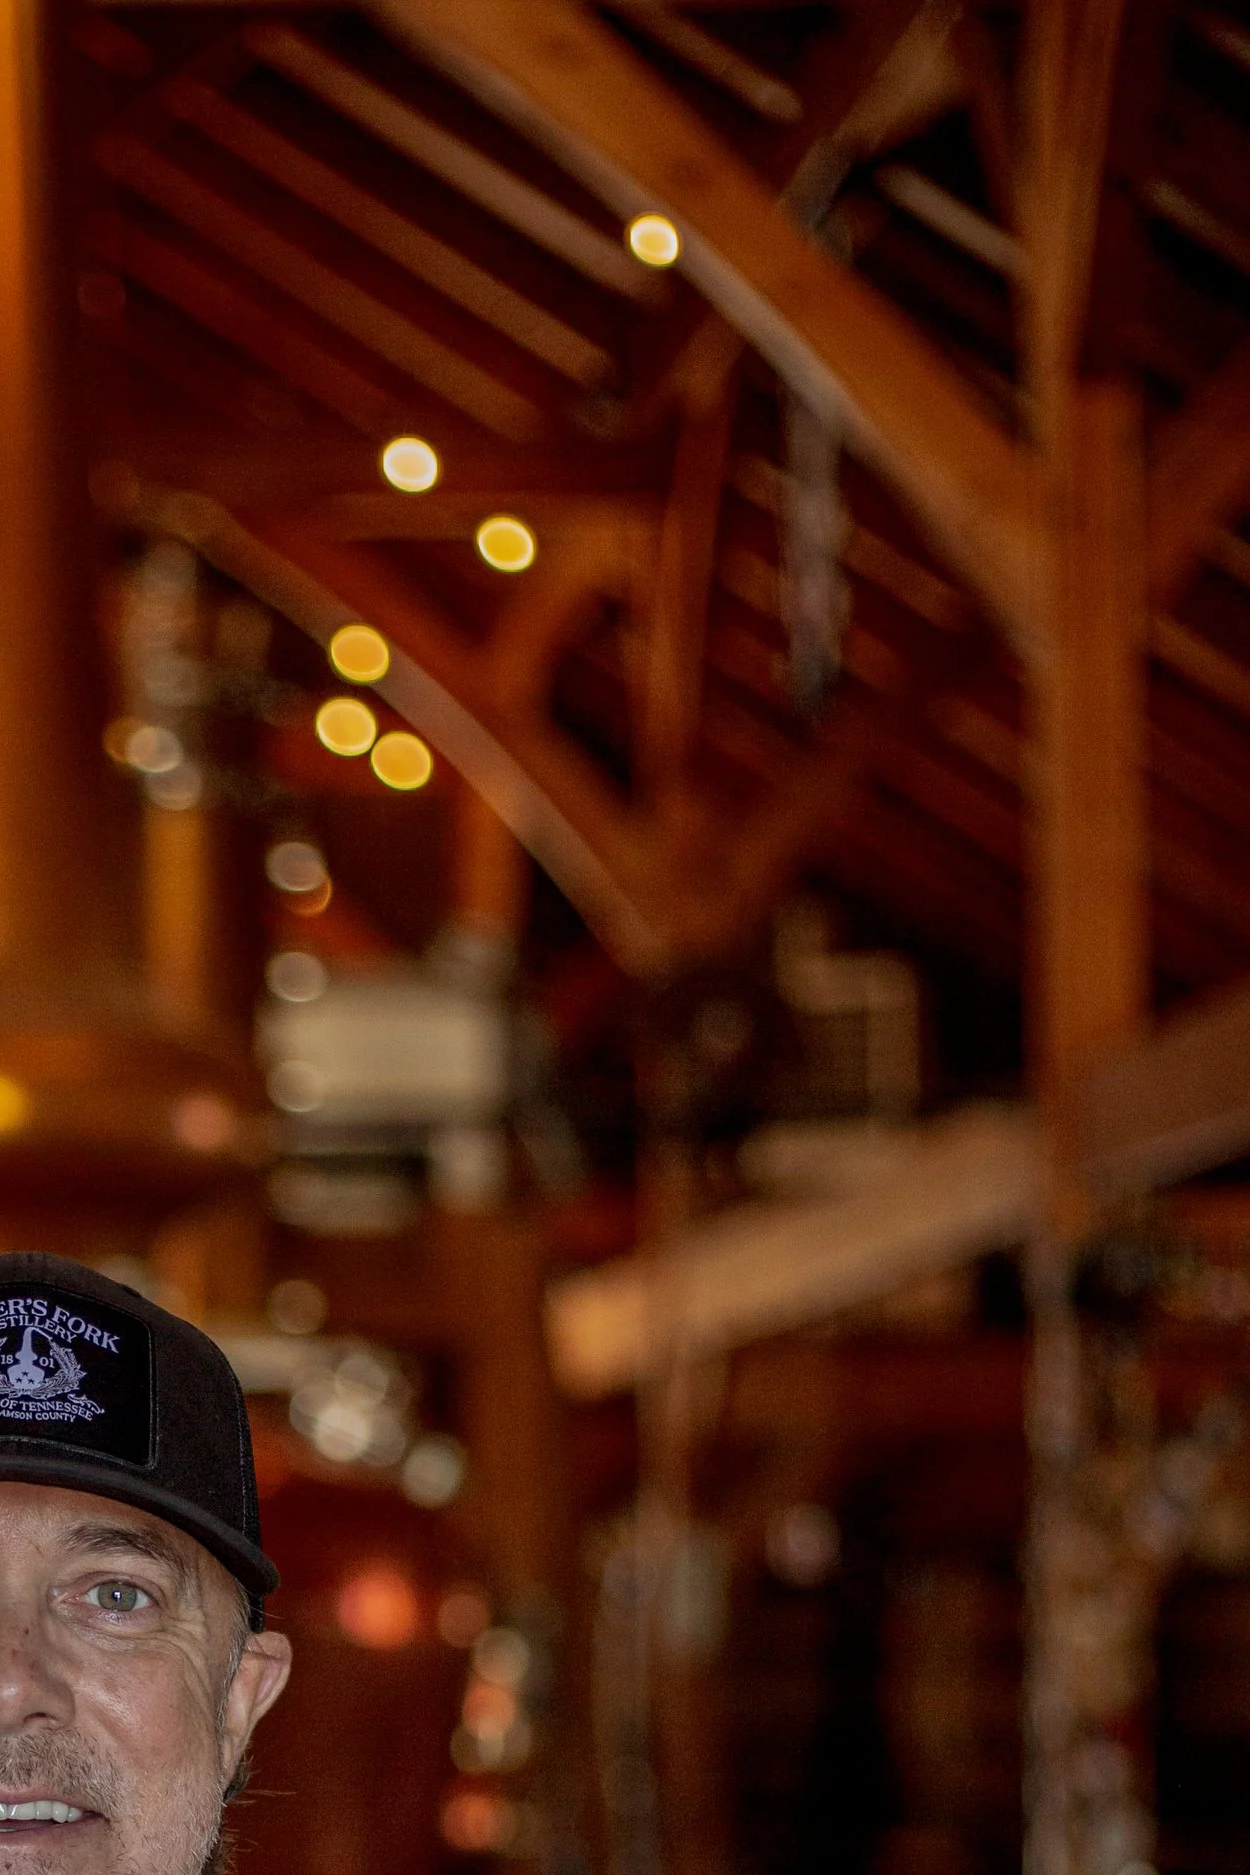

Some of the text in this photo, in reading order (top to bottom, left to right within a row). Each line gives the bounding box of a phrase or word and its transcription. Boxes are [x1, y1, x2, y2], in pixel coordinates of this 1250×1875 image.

[53, 1306, 121, 1355] FORK
[0, 1354, 14, 1365] 18
[0, 1398, 18, 1409] OF
[18, 1400, 95, 1422] TENNESSEE
[35, 1412, 77, 1424] COUNTY
